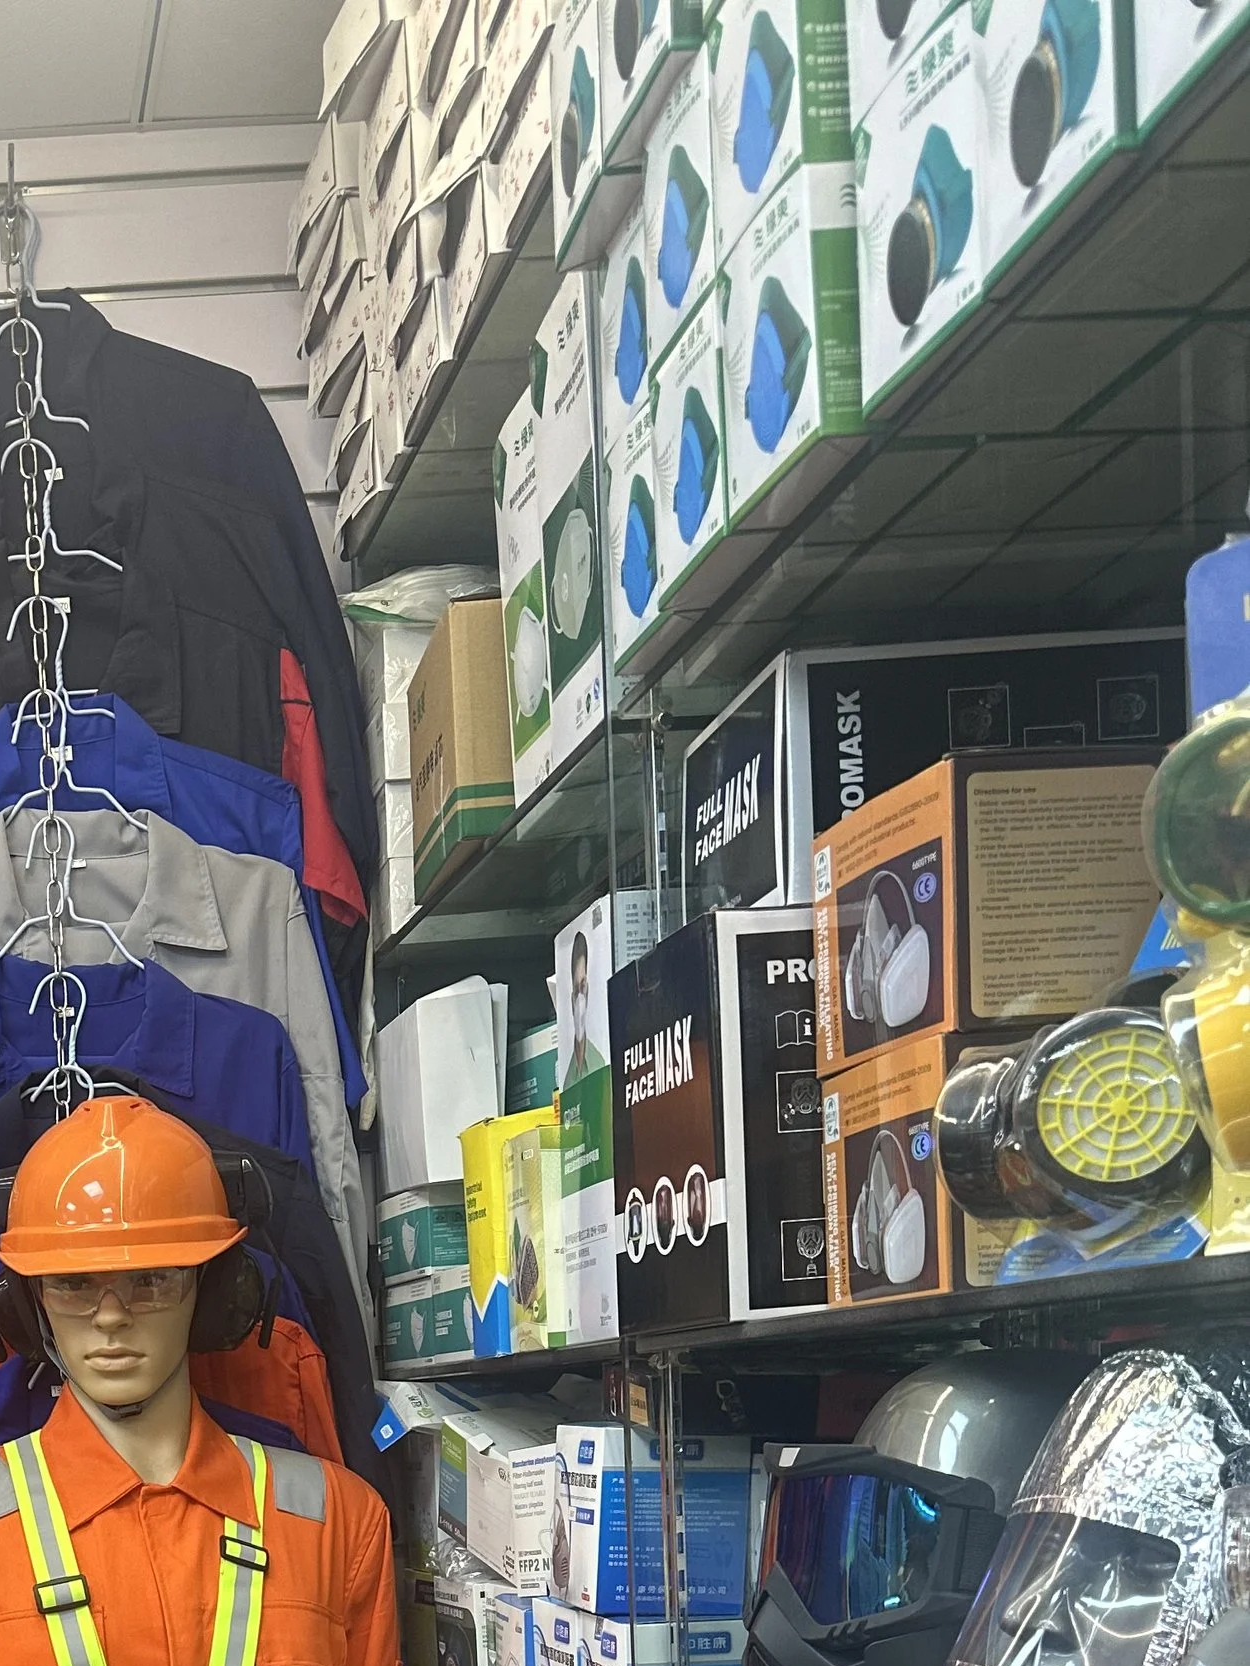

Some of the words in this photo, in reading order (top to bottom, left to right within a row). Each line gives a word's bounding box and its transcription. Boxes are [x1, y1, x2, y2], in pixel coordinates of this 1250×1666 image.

[836, 689, 865, 820] OMASK
[695, 787, 723, 833] FULL
[723, 753, 761, 847] MASK
[694, 821, 724, 867] FACE
[623, 1037, 653, 1074] FULL
[653, 1014, 694, 1097] MASK
[625, 1071, 655, 1109] FACE
[518, 1558, 540, 1573] FFP2
